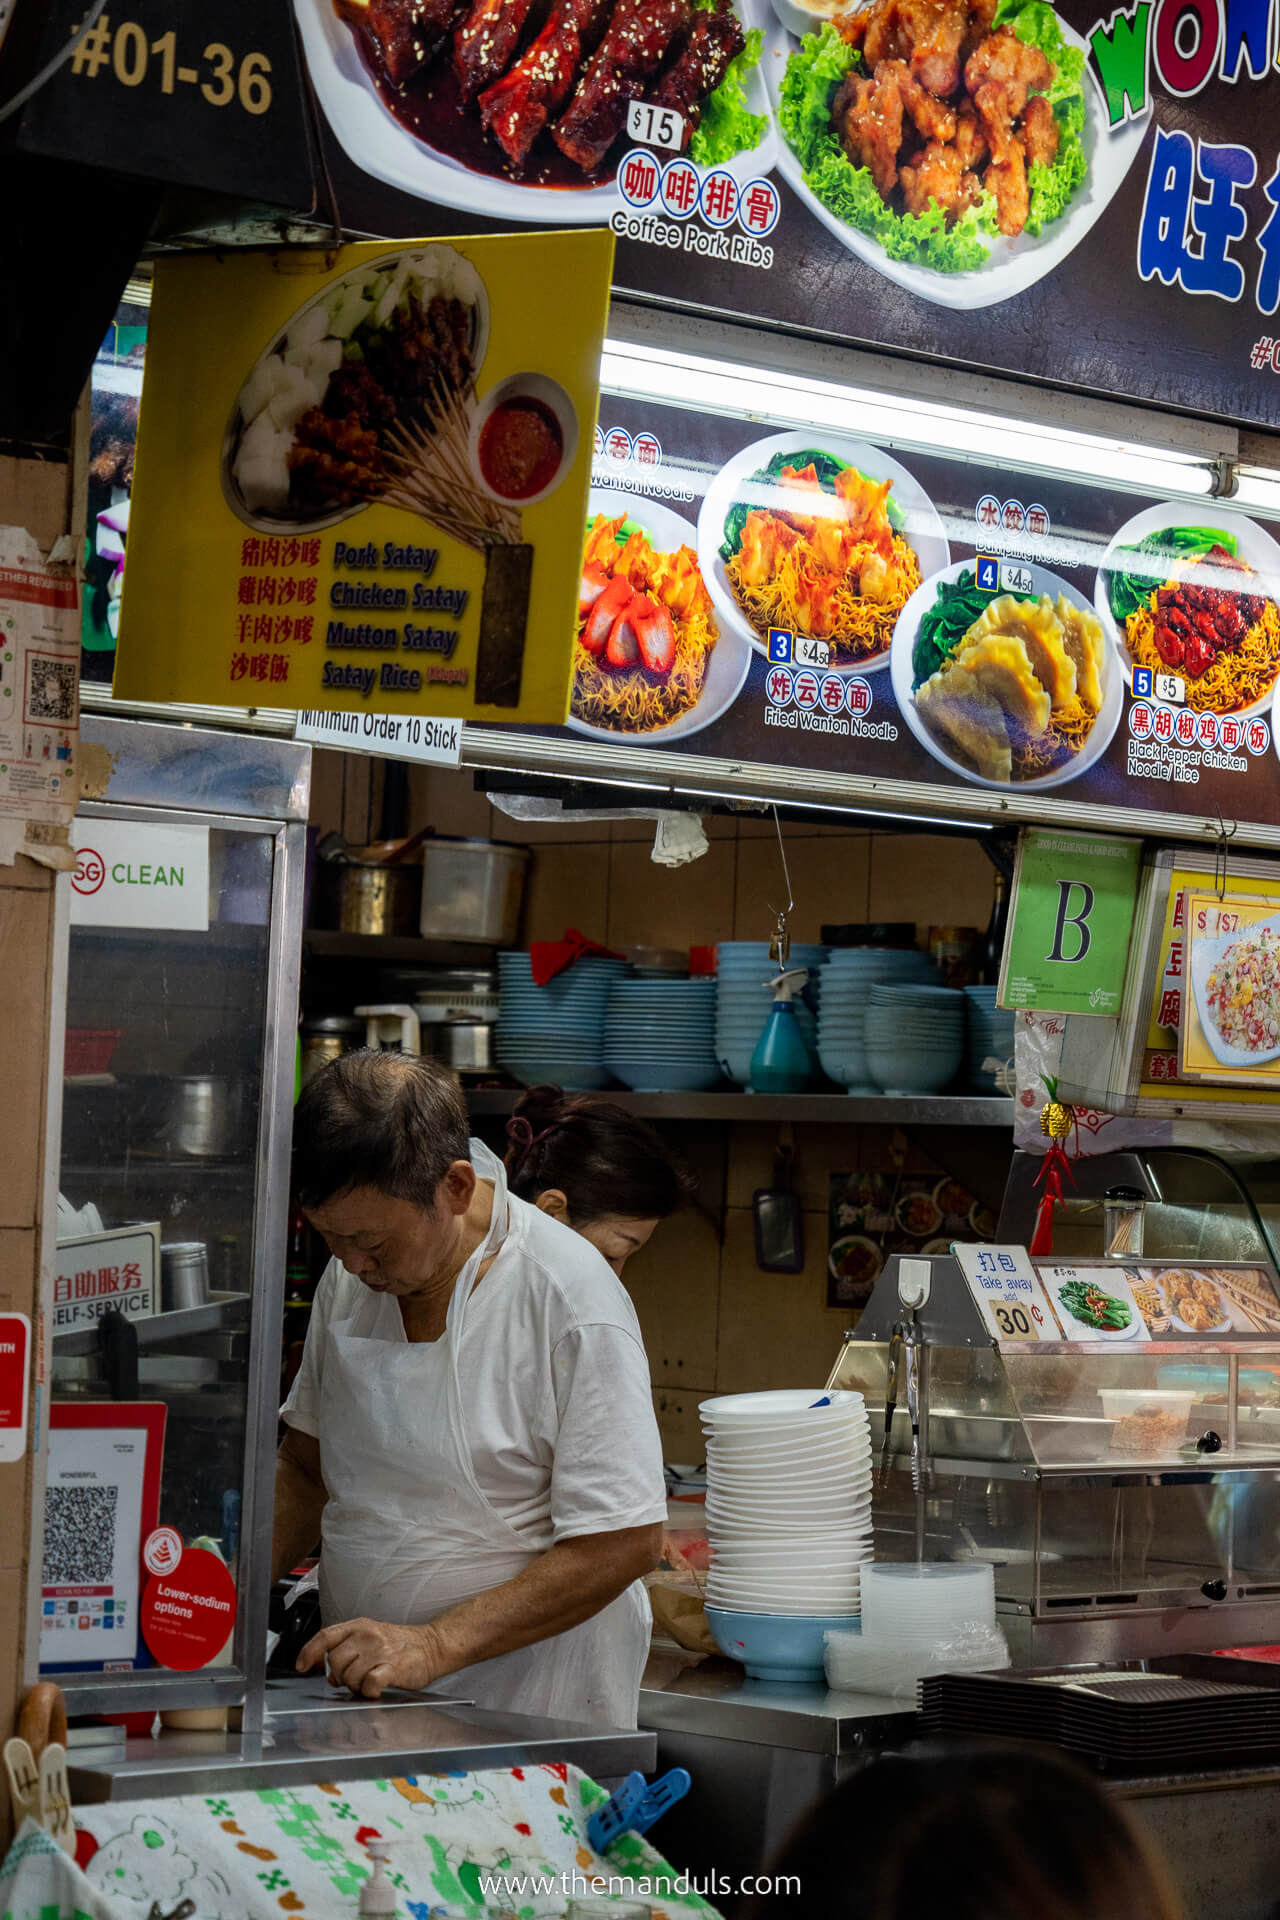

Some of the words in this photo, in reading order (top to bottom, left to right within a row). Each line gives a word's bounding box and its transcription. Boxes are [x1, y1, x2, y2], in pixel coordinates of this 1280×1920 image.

[71, 10, 272, 115] #01-36
[1086, 0, 1280, 131] WON
[633, 107, 674, 145] $15
[624, 158, 775, 230] 咖啡排骨
[612, 211, 681, 247] Coffee
[686, 226, 727, 258] Pork
[732, 238, 772, 267] Ribs
[980, 502, 1046, 534] 水饺面
[333, 542, 378, 569] Pork
[382, 542, 437, 575] Satay
[982, 565, 994, 586] 4
[330, 582, 408, 608] Chicken
[412, 583, 468, 616] Satay
[326, 621, 397, 648] Mutton
[402, 623, 457, 657] Satay
[775, 635, 788, 658] 3
[322, 661, 376, 695] Satay
[380, 663, 420, 689] Rice
[770, 672, 869, 713] 炸云吞面
[1137, 672, 1149, 694] 5
[1162, 677, 1177, 698] $5
[363, 713, 402, 741] Order
[406, 718, 420, 744] 10
[424, 721, 458, 751] Stick
[765, 707, 798, 727] Fried
[800, 712, 849, 734] Wanton
[851, 719, 898, 741] Noodle
[1132, 707, 1266, 750] 黑胡椒鸡面/饭
[1128, 740, 1159, 759] Black
[1161, 745, 1201, 765] Pepper
[1202, 752, 1247, 771] Chicken
[1128, 759, 1173, 779] Noodle/
[1174, 766, 1199, 783] Rice
[73, 861, 101, 882] SG
[111, 863, 184, 887] CLEAN
[1045, 879, 1095, 963] B
[977, 1252, 1017, 1272] 打包
[53, 1263, 143, 1303] 自助服务
[975, 1275, 1003, 1289] Take
[1005, 1279, 1033, 1293] away
[1003, 1292, 1018, 1301] add
[153, 1600, 193, 1620] options
[157, 1583, 231, 1613] Lower-sodium
